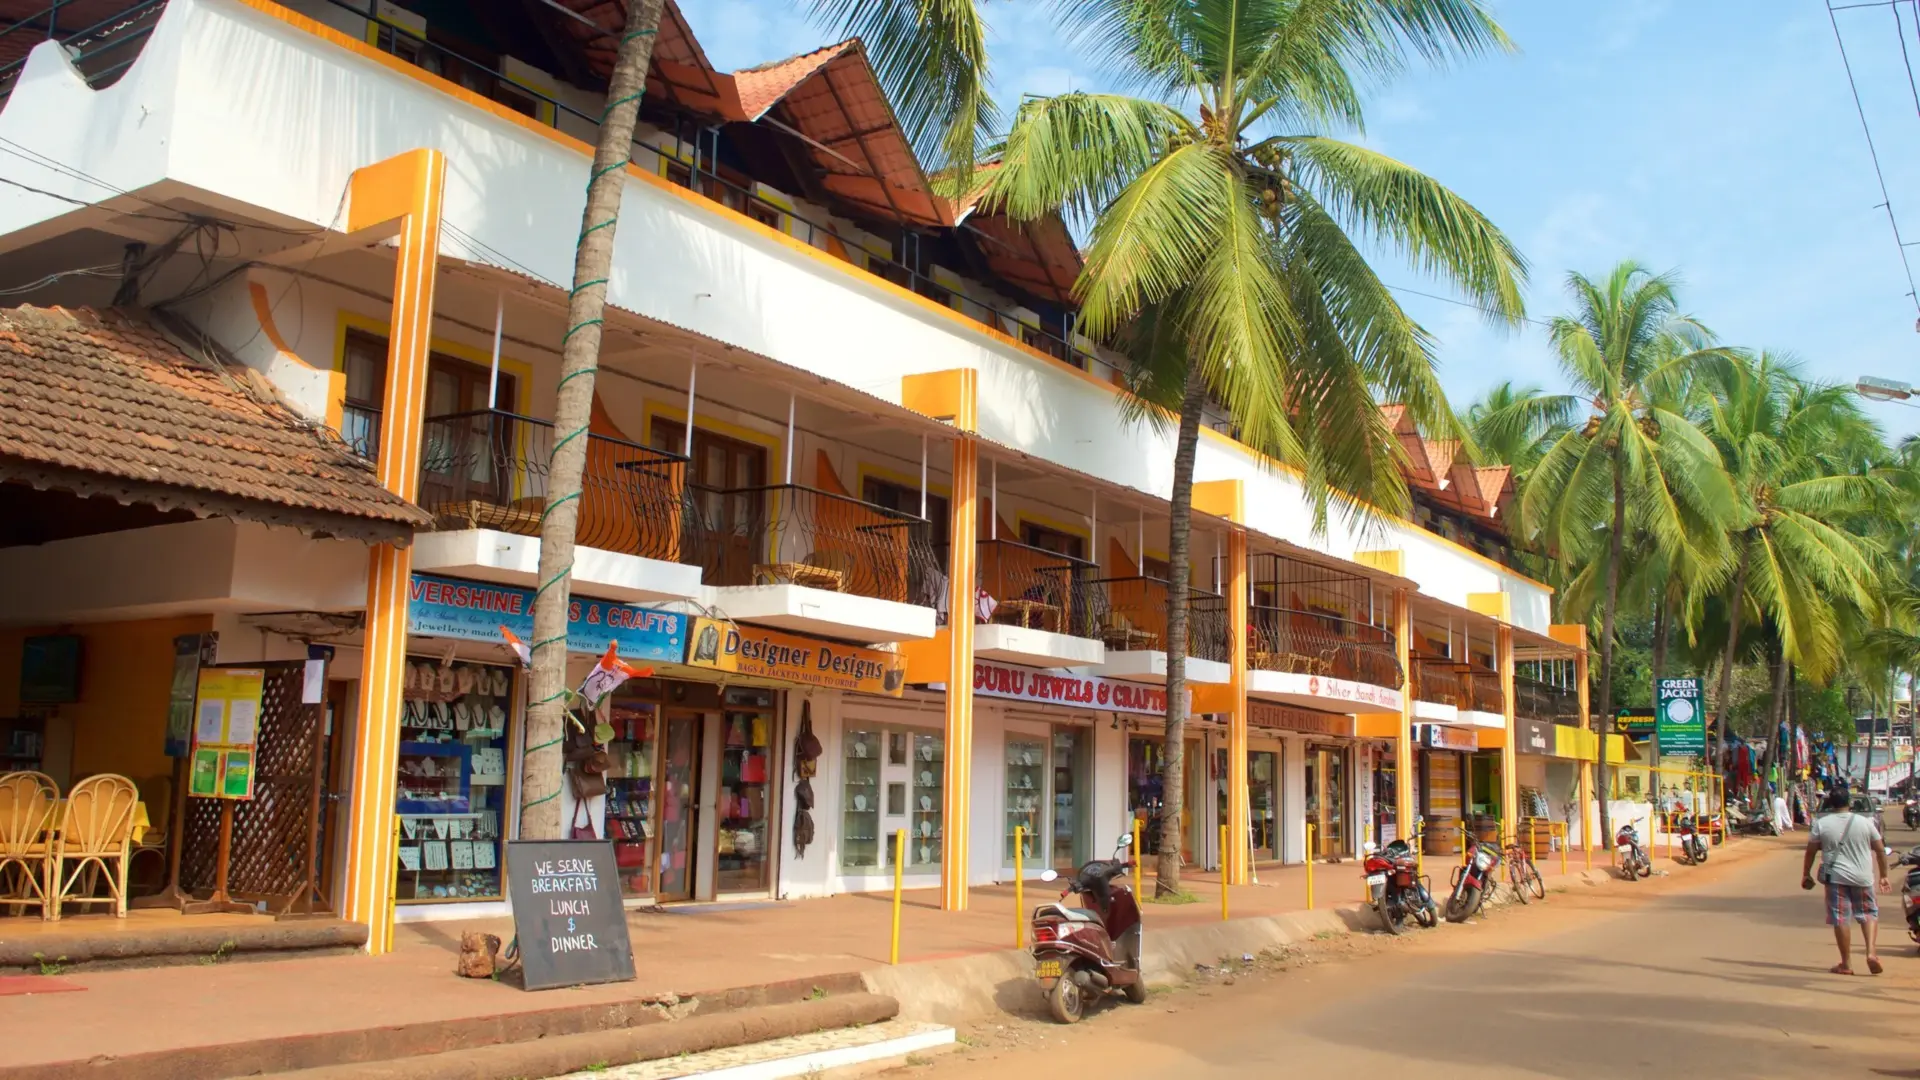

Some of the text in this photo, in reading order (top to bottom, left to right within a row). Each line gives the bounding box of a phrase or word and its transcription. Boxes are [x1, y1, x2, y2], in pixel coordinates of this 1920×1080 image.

[586, 604, 600, 625] &
[607, 607, 678, 635] CRAFTS
[414, 621, 469, 635] Jewellery
[471, 630, 499, 638] made
[724, 630, 884, 680] Designer Designs
[737, 662, 859, 689] BAGS & JACKETS MADE TO ORDER
[1662, 679, 1696, 689] GREEN
[973, 664, 1168, 712] GURU JEWELS & CRAFTS
[1325, 680, 1351, 698] Silver
[1660, 688, 1699, 700] JACKET
[535, 858, 594, 875] WE SERVE
[531, 877, 598, 893] BREAKFAST
[550, 899, 590, 915] LUNCH
[551, 934, 598, 953] DINNER
